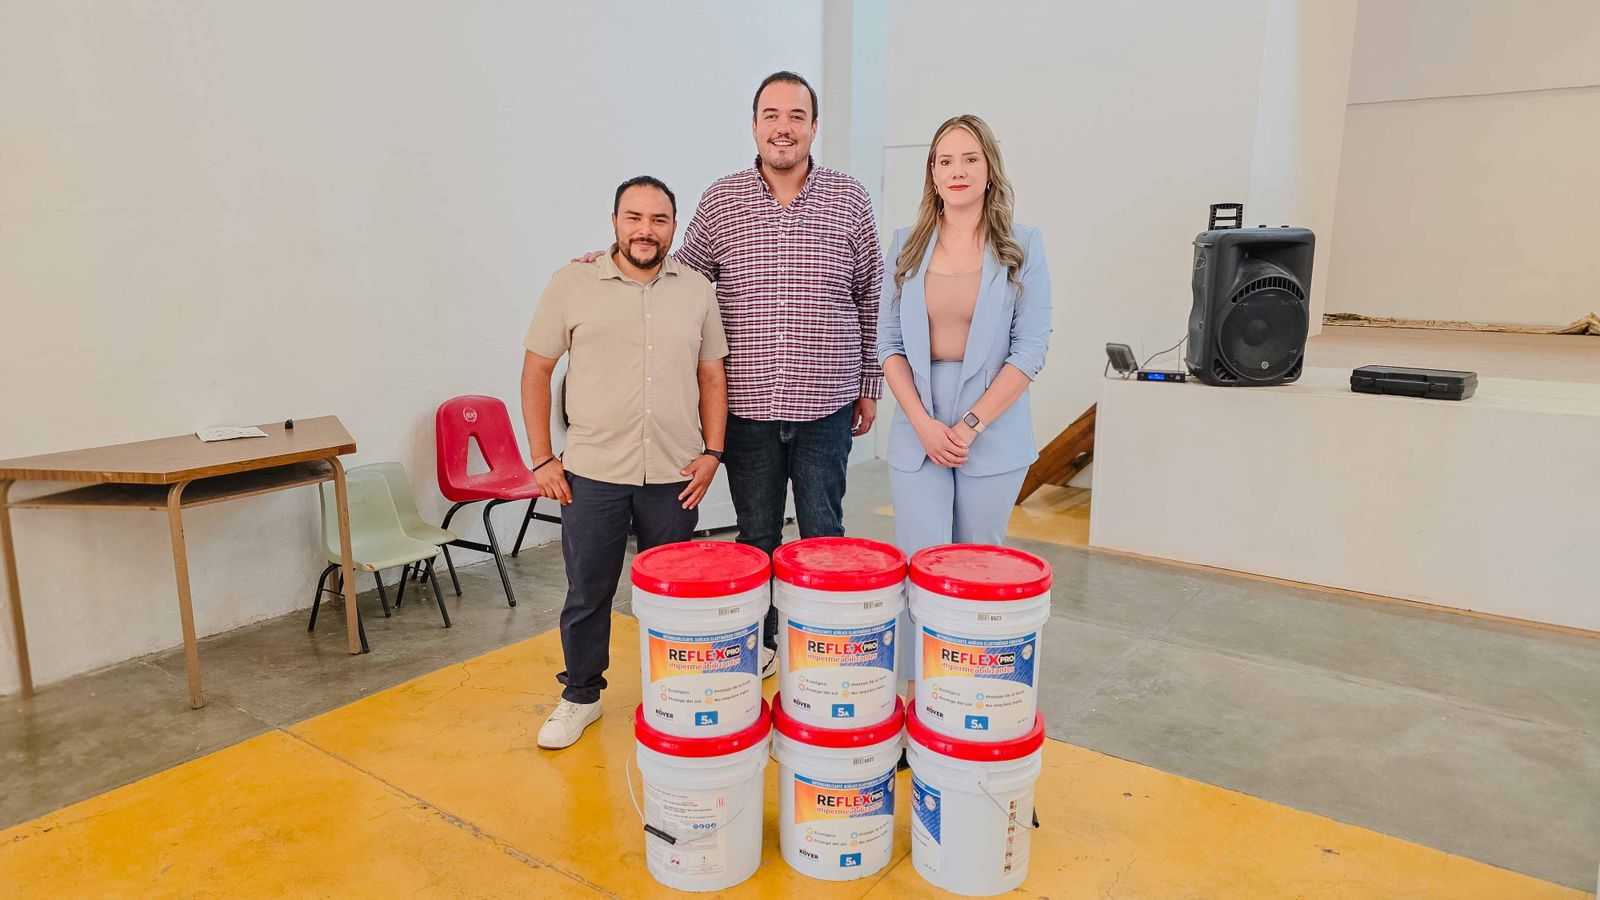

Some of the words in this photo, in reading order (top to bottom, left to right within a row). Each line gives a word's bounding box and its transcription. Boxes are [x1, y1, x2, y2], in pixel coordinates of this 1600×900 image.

[669, 649, 724, 662] REFLEX
[726, 646, 740, 656] PRO
[808, 640, 862, 654] REFLEX
[863, 640, 877, 651] PRO
[942, 648, 999, 666] REFLEX
[1000, 655, 1014, 663] PRO
[817, 794, 871, 807] REFLEX
